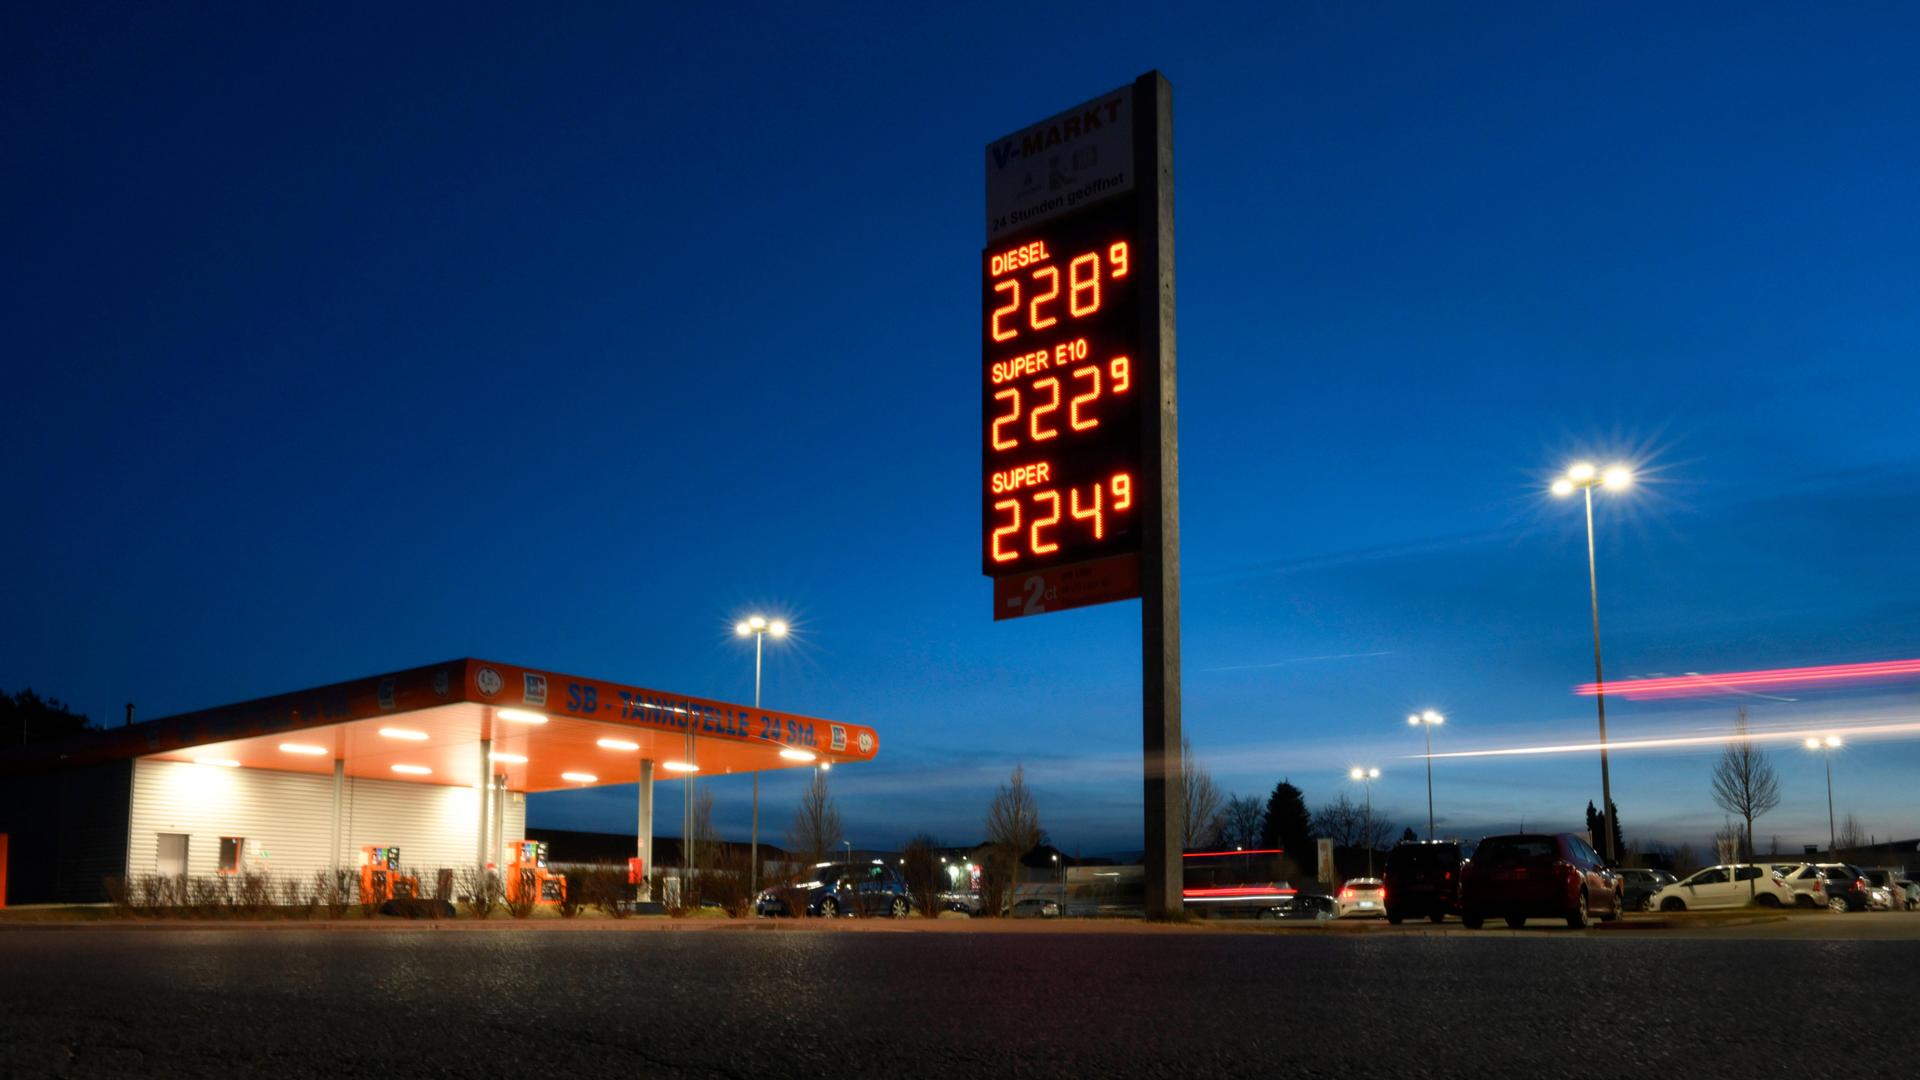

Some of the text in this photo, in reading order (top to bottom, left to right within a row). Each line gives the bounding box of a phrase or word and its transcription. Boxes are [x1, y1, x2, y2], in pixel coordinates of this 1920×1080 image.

[993, 98, 1122, 169] V-MARKT
[993, 172, 1124, 232] 24 Stunden geöffnet
[992, 240, 1049, 276] DIESEL
[992, 338, 1087, 384] SUPER E10
[992, 462, 1050, 493] SUPER
[567, 683, 597, 713] SB
[619, 691, 749, 737] TANKSTELLE
[760, 715, 781, 741] 24
[787, 719, 818, 747] Std.
